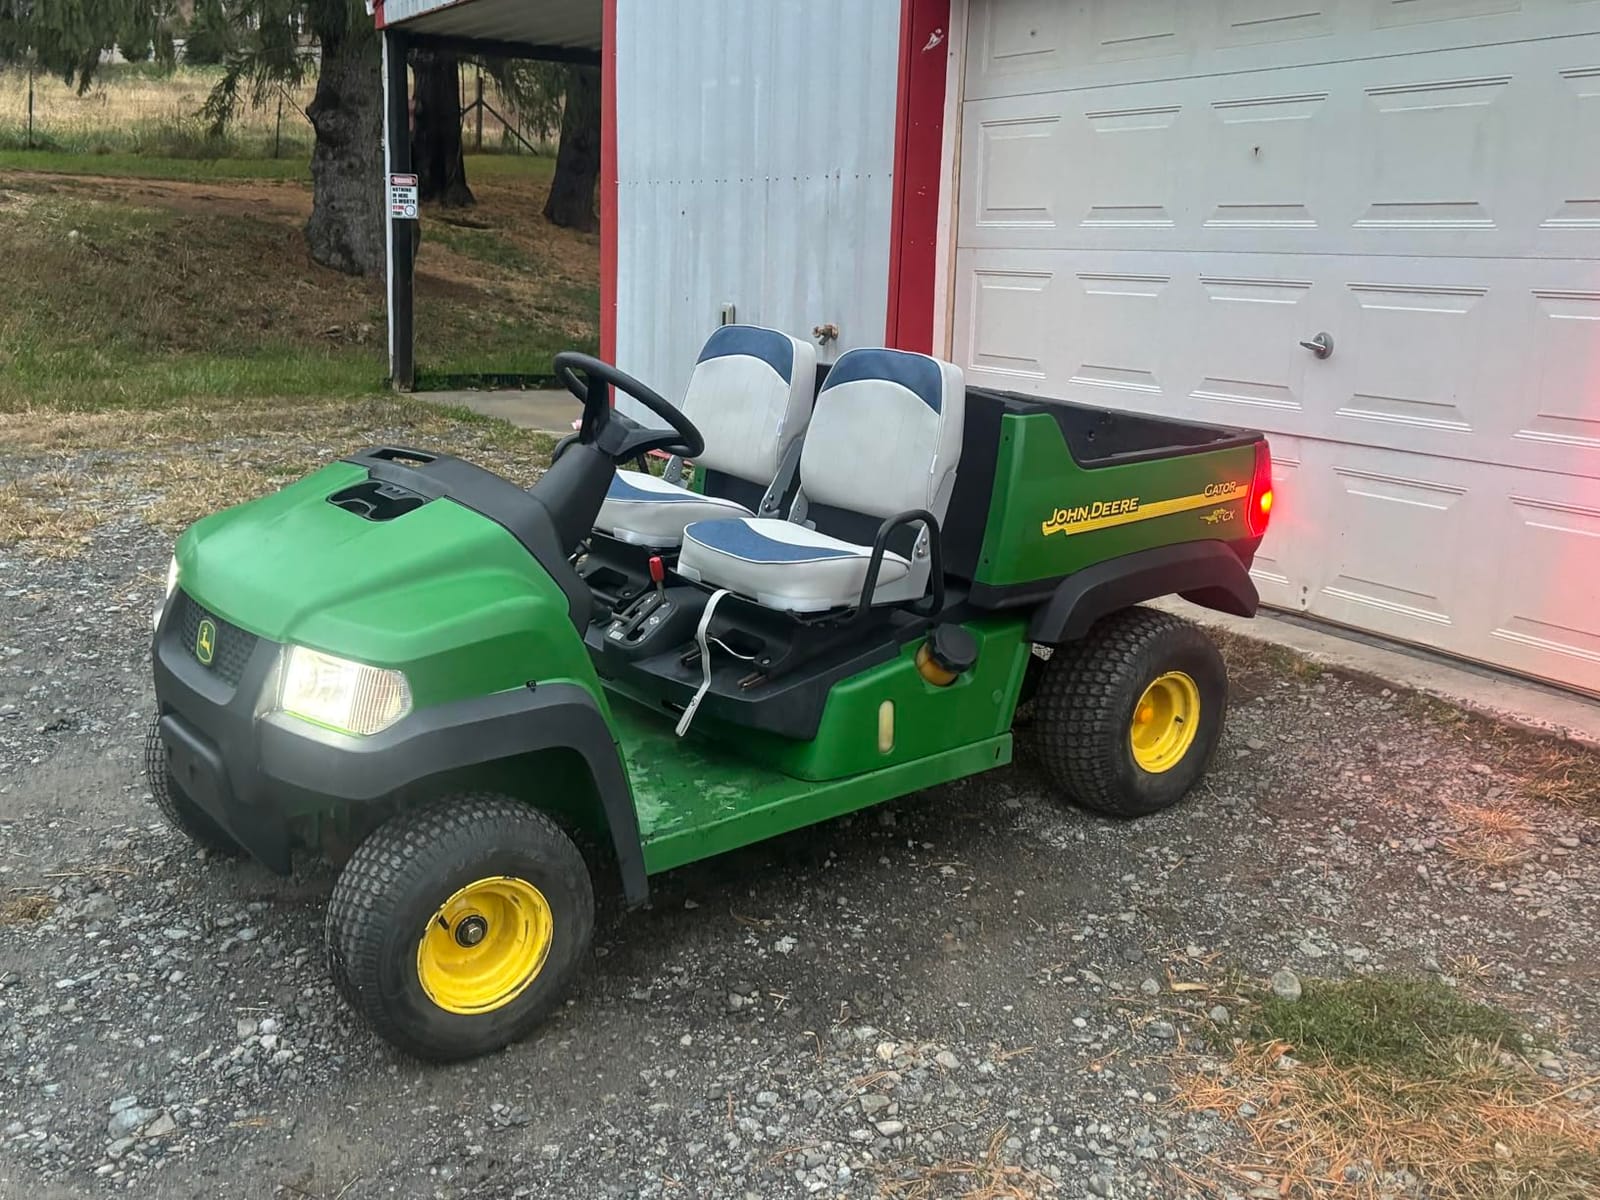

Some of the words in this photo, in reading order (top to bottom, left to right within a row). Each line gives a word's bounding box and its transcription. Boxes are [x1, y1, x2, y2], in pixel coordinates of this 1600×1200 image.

[1204, 481, 1237, 497] GATOR
[1046, 507, 1091, 525] JOHN
[1090, 497, 1140, 519] DEERE
[1222, 510, 1236, 521] CX
